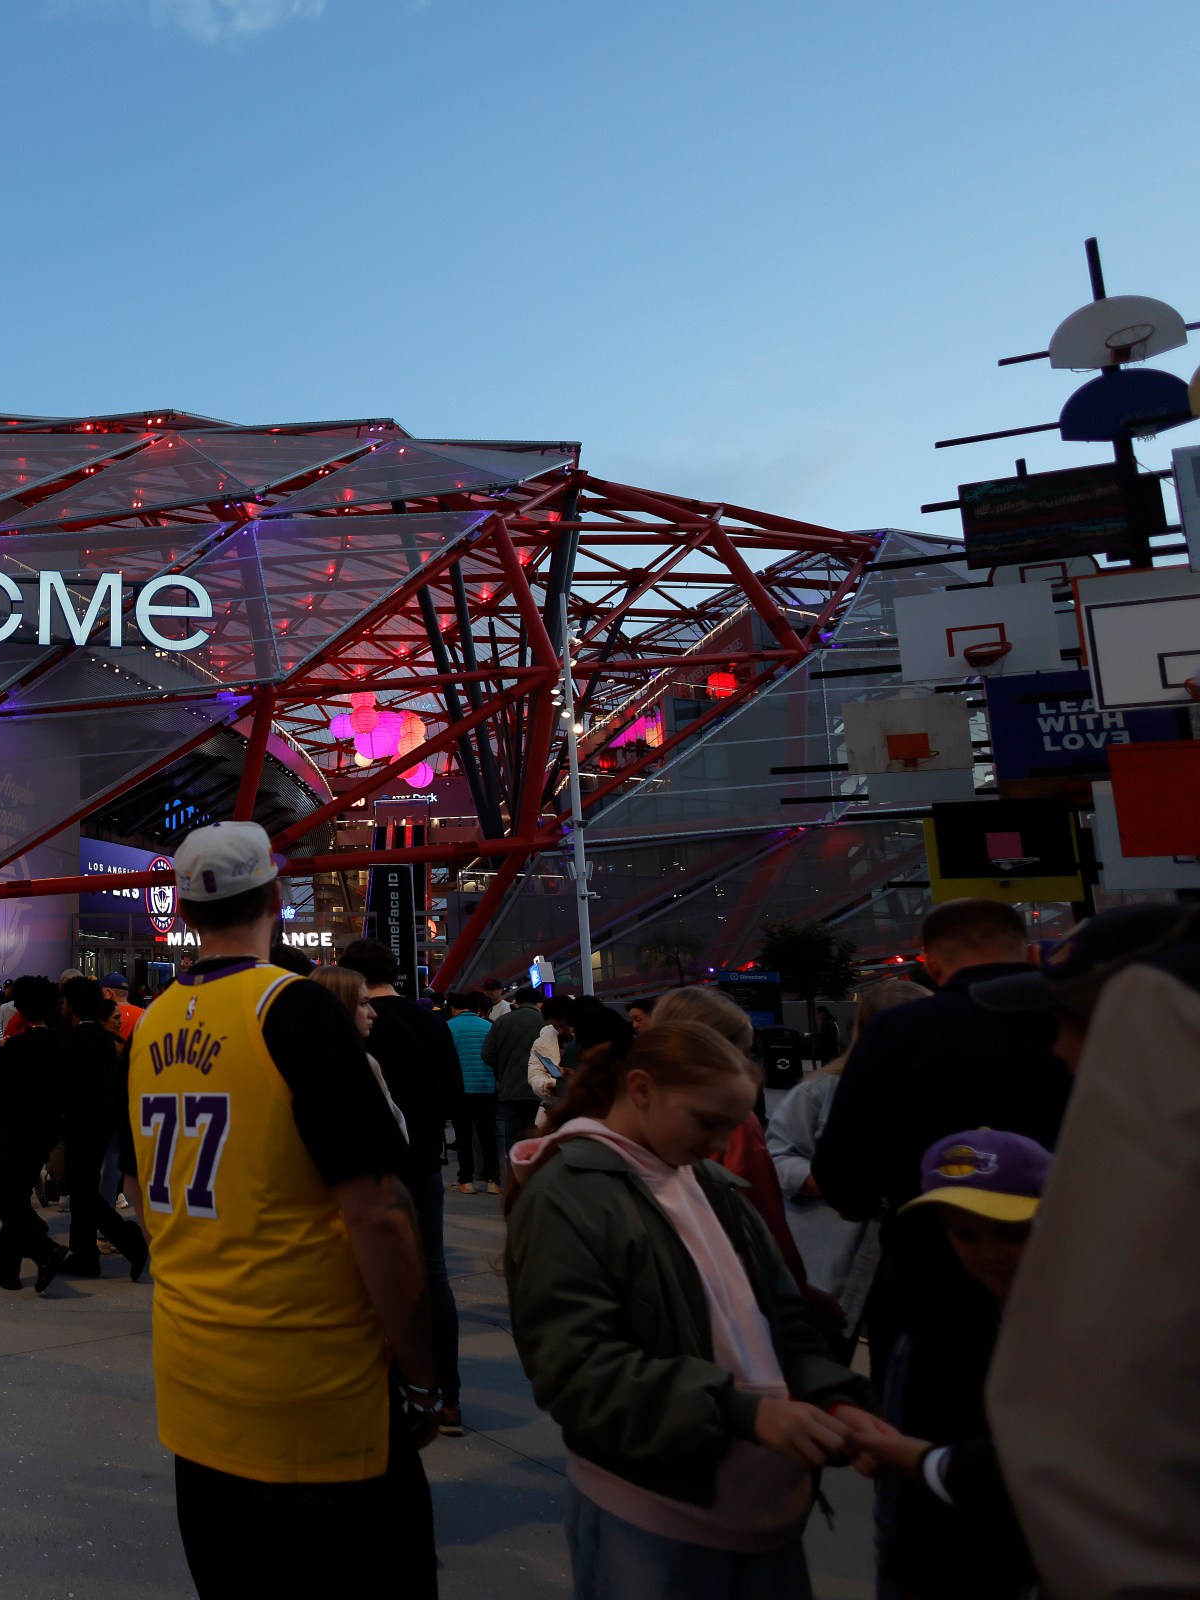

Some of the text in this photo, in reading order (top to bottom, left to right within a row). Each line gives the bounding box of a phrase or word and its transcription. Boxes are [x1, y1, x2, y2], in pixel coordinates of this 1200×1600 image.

[1039, 699, 1095, 714] LEA
[1036, 712, 1125, 733] WITH
[88, 862, 139, 874] LOS ANGEL
[388, 872, 399, 887] ID
[281, 932, 333, 947] ANCE
[149, 1020, 228, 1077] DONČIĆ
[140, 1092, 231, 1219] 77
